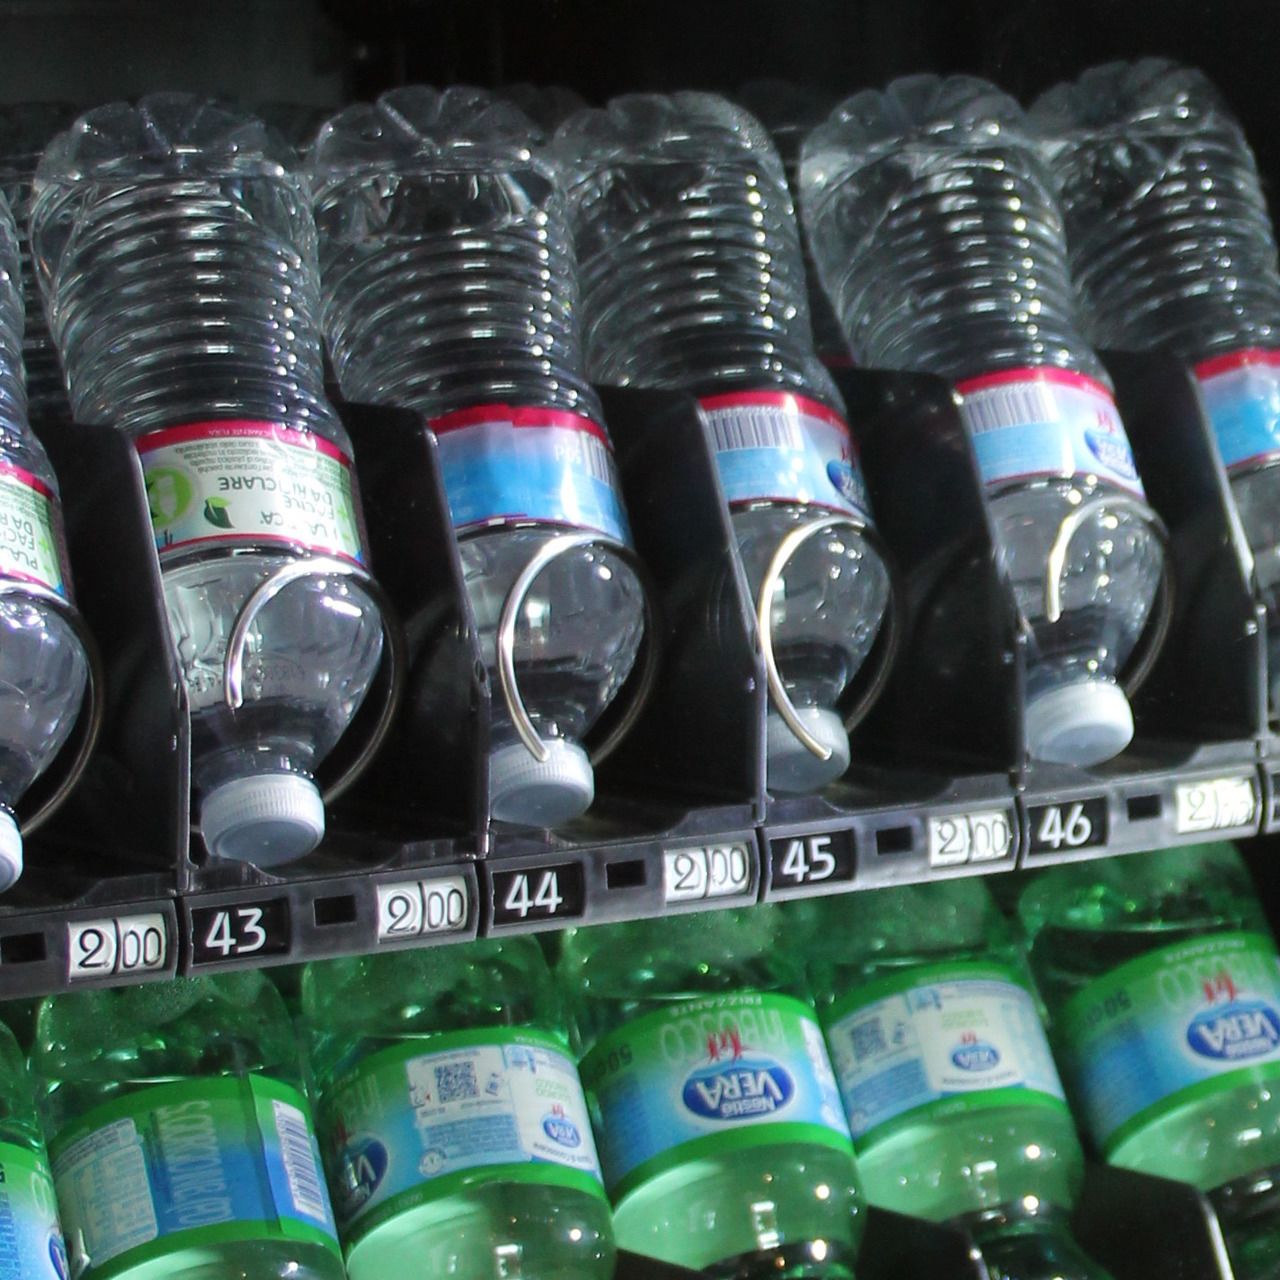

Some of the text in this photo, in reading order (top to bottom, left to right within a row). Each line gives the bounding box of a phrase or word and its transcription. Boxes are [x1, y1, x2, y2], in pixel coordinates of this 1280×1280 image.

[1039, 802, 1093, 849] 46
[780, 835, 837, 883] 45
[504, 871, 564, 919] 44
[204, 906, 268, 957] 43
[696, 1067, 785, 1112] VERA
[721, 1095, 778, 1121] Nestlé
